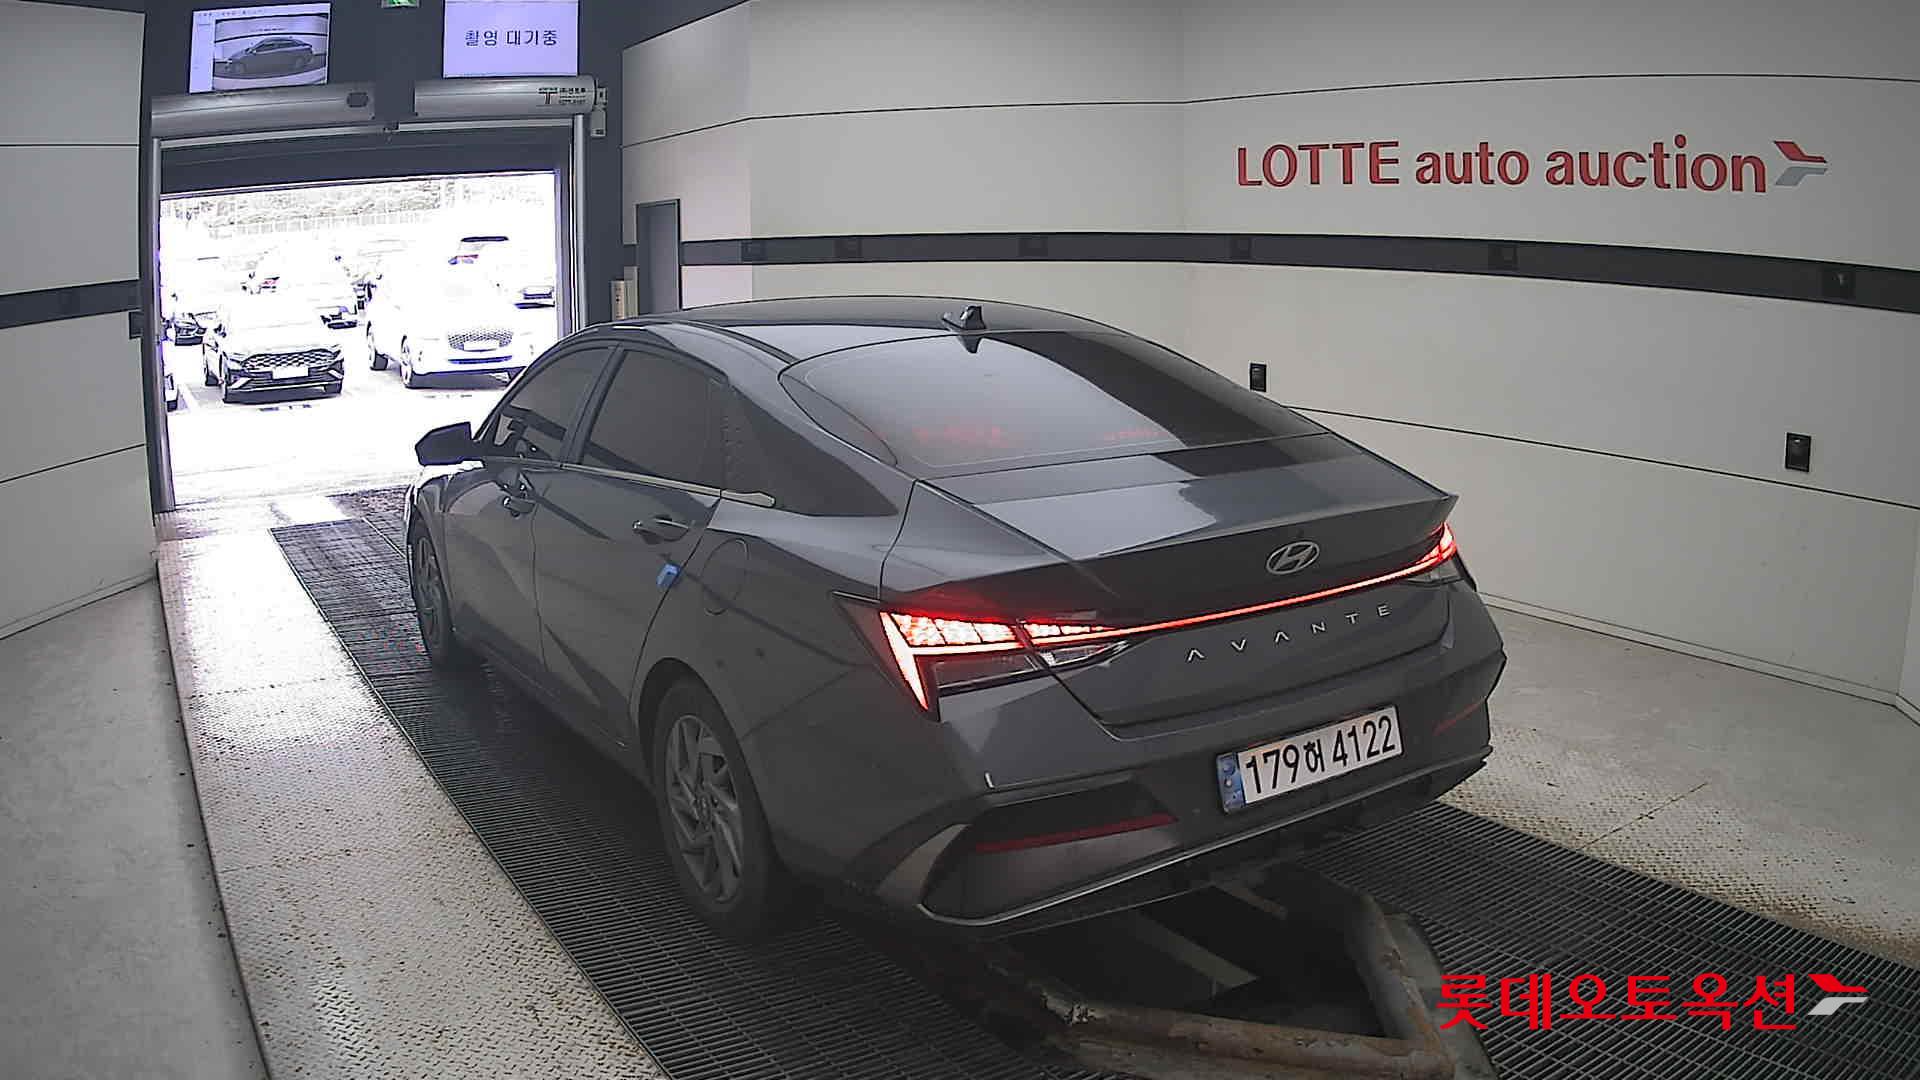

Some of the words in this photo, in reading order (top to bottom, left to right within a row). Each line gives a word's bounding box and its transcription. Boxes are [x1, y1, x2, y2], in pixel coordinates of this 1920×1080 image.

[465, 30, 498, 47] 촬영
[506, 30, 557, 46] 대기중
[1236, 141, 1400, 187] LOTTE
[1415, 141, 1530, 185] auto
[1545, 134, 1767, 193] auction
[1187, 604, 1392, 662] AVANTE
[1245, 739, 1326, 794] 179허
[1332, 715, 1396, 767] 4122
